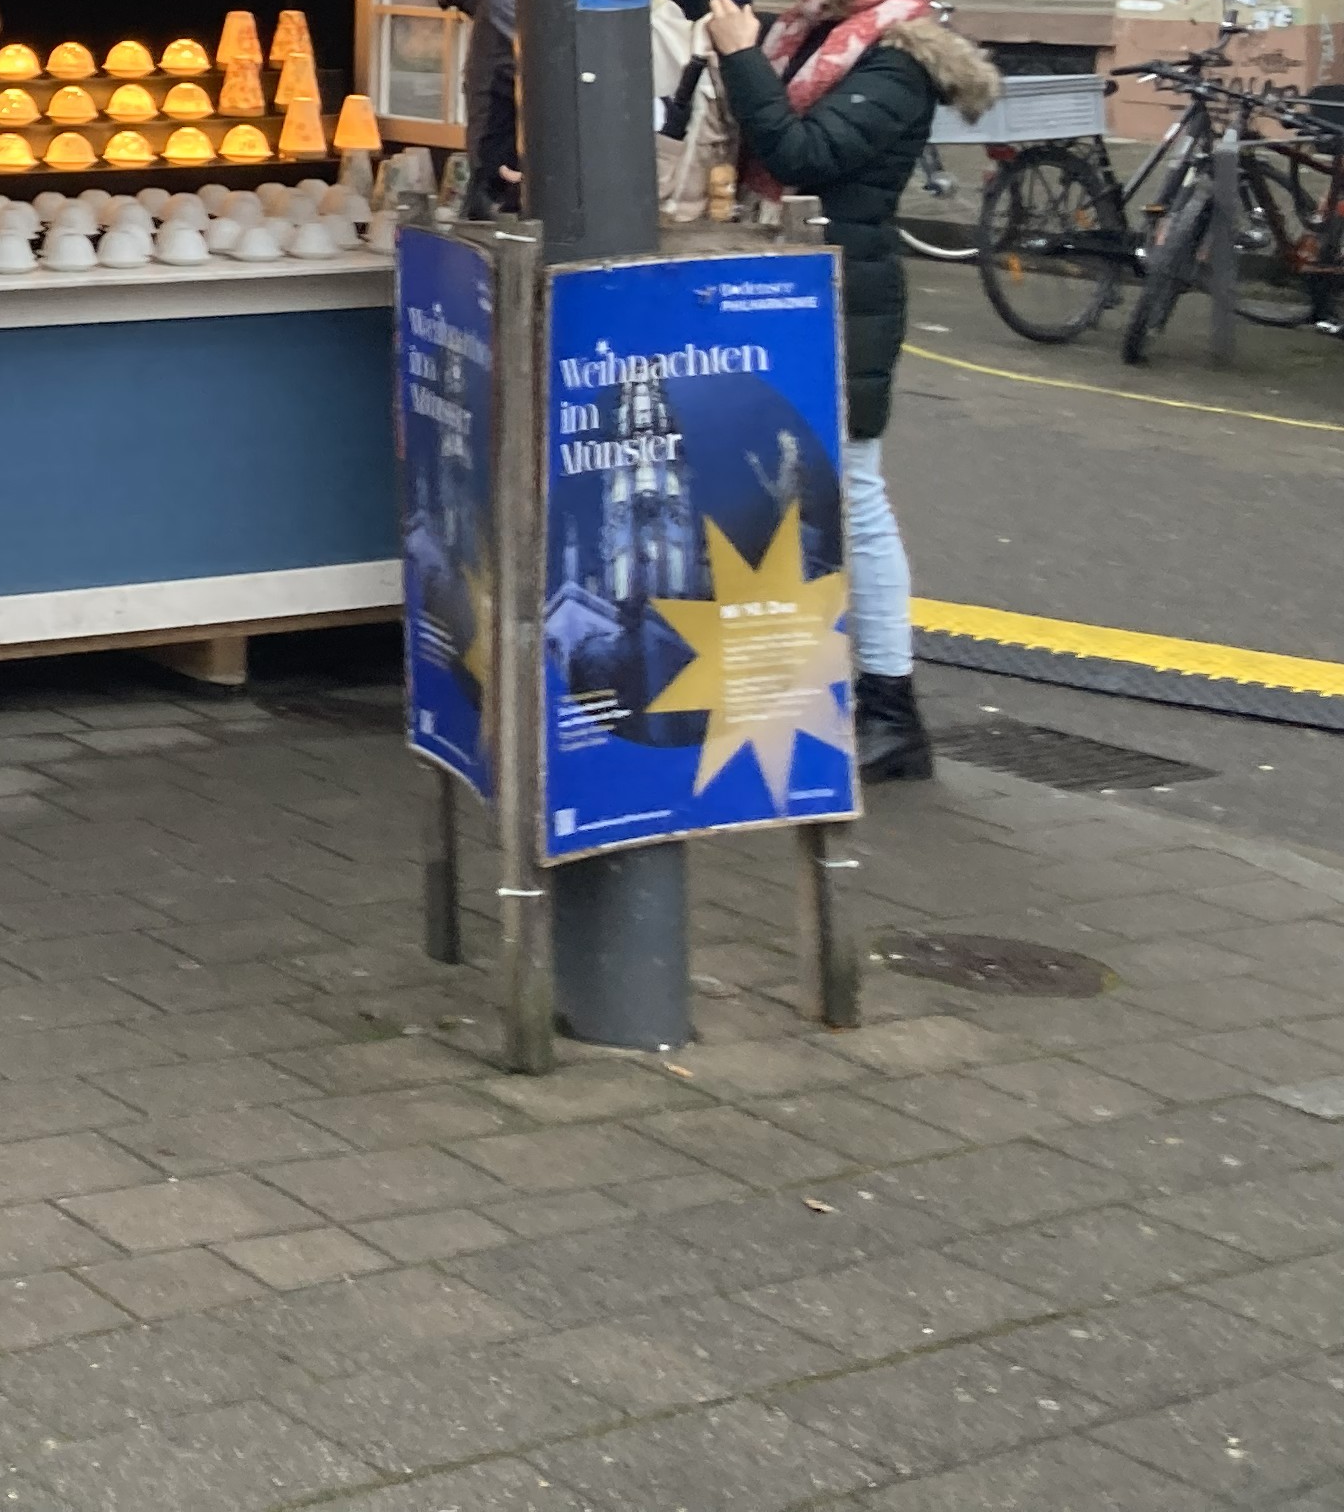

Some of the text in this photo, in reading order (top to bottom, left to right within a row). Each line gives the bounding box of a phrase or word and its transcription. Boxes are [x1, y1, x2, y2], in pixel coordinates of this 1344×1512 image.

[559, 340, 770, 389] Weihnachten
[559, 400, 601, 434] im
[559, 433, 683, 476] Münster
